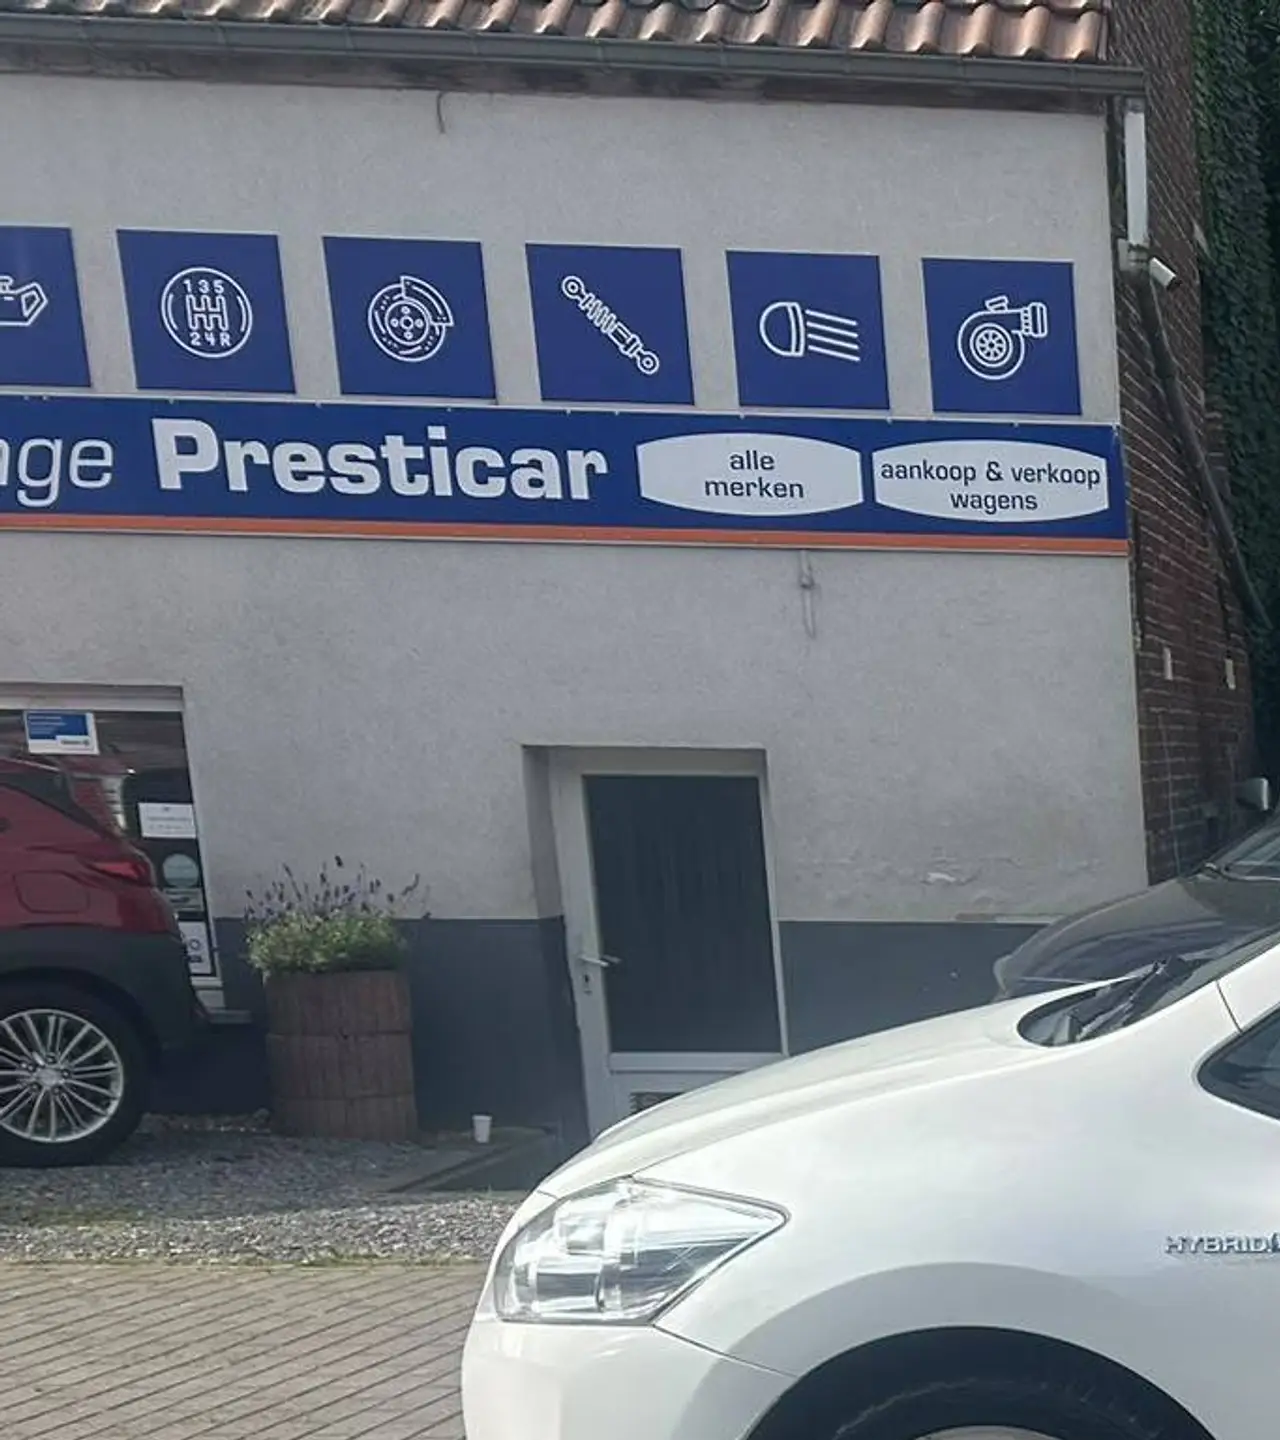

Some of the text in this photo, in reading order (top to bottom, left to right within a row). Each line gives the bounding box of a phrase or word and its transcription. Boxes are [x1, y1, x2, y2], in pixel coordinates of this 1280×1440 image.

[0, 417, 609, 507] ge Presticar
[729, 449, 775, 471] alle
[881, 459, 1101, 487] aankoop & verkoop
[704, 477, 804, 499] merken
[949, 491, 1038, 511] wagens
[1165, 1234, 1267, 1254] HYBRID
